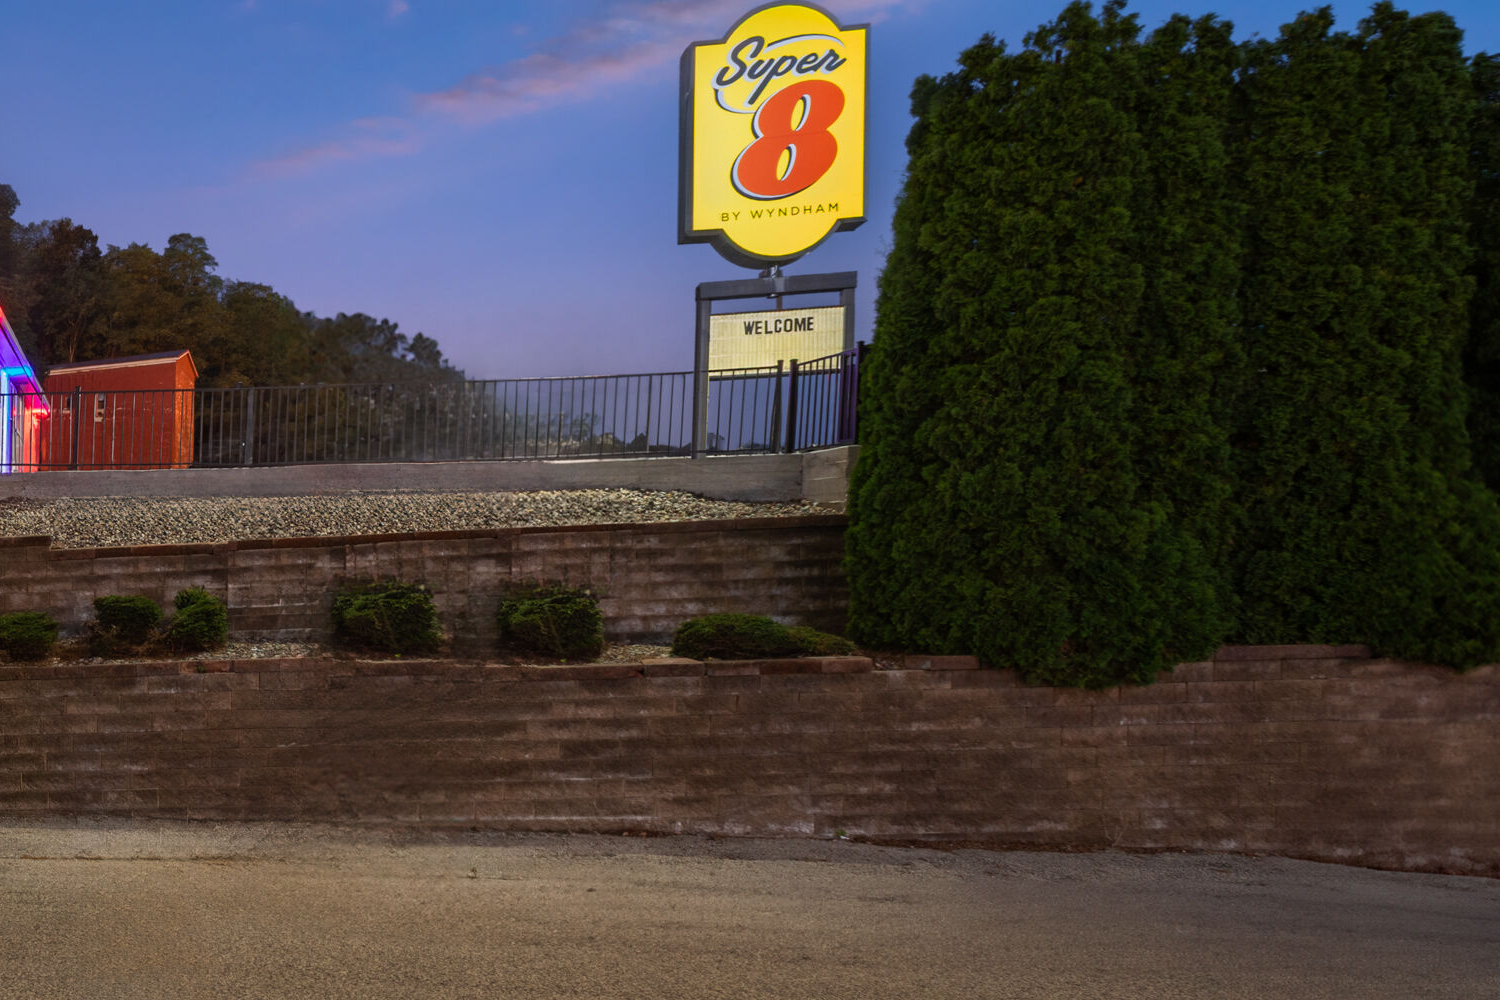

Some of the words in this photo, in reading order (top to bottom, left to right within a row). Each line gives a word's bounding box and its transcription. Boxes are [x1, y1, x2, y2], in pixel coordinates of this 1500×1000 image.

[715, 35, 847, 106] Super
[731, 79, 846, 201] 8
[721, 211, 741, 222] BY
[750, 202, 840, 218] WYNDHAM
[744, 317, 814, 335] WELCOME
